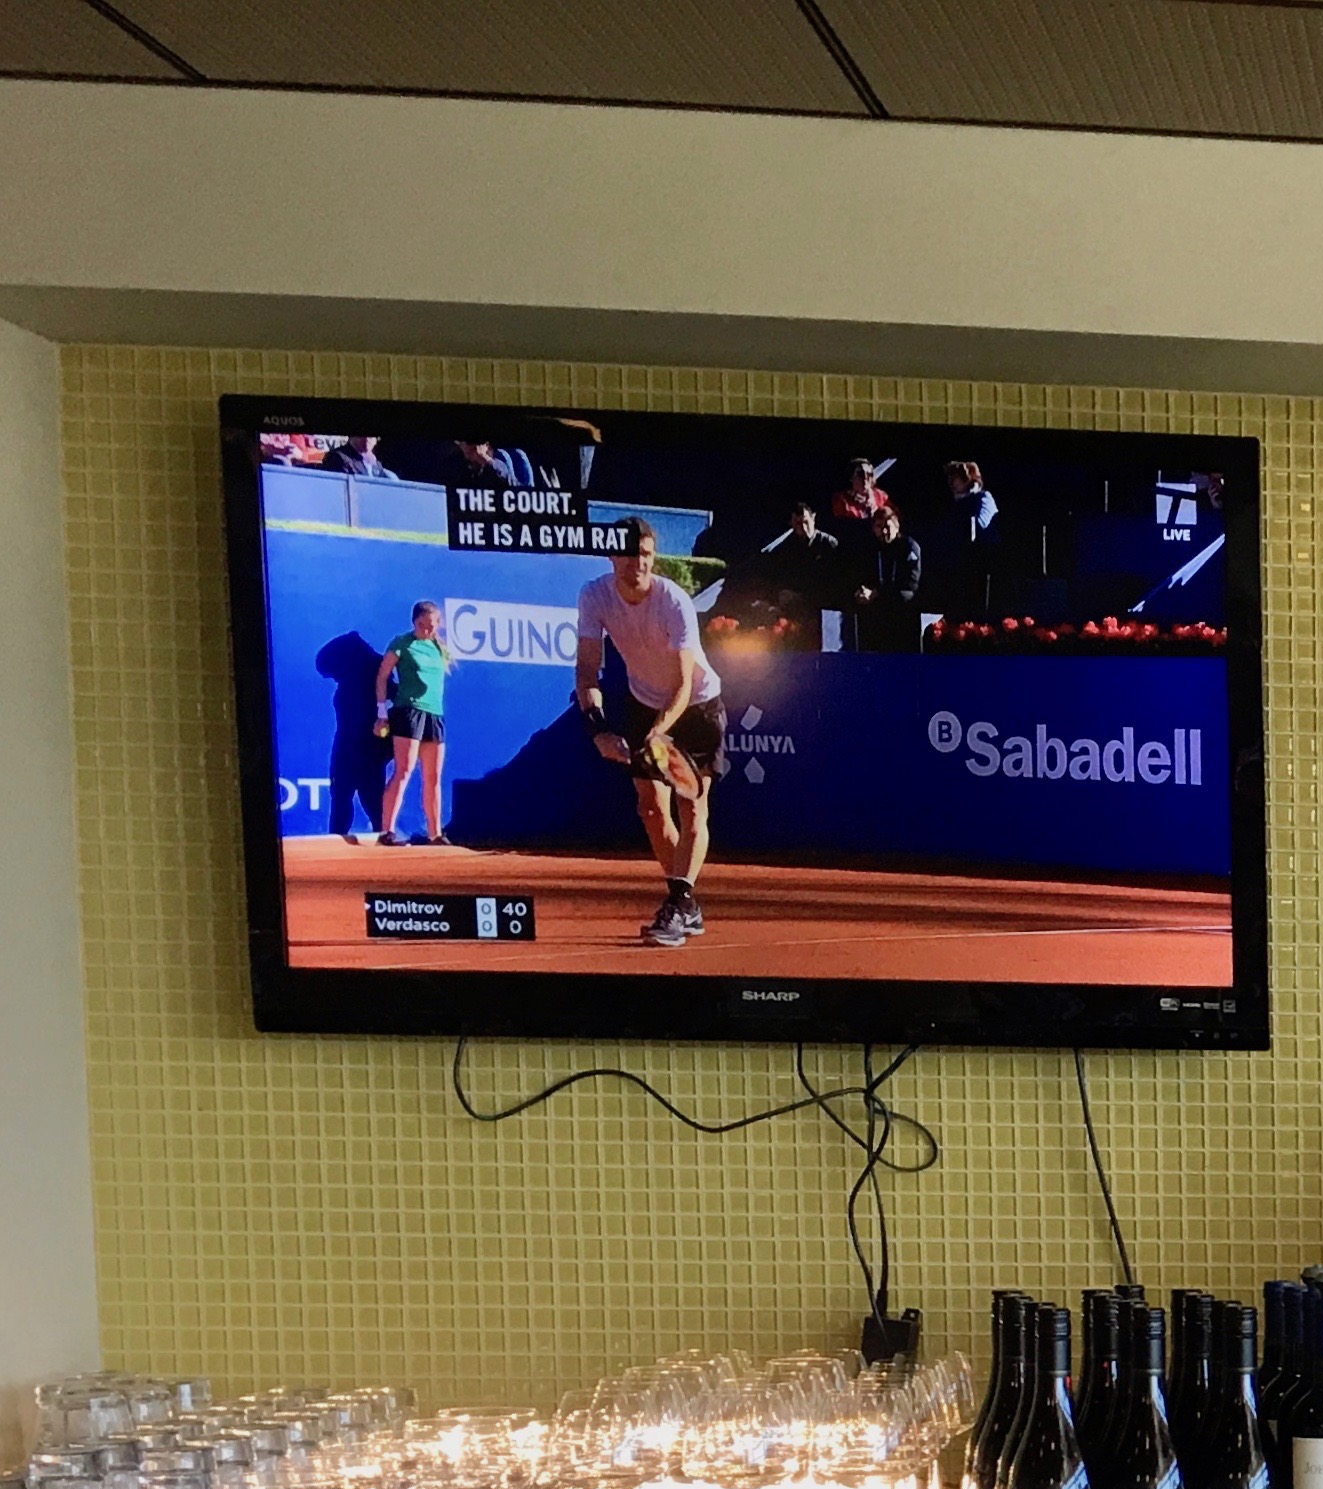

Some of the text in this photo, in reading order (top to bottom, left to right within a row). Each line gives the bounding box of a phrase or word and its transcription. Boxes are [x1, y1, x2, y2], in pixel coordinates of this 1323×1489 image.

[262, 416, 305, 427] AQUOS
[455, 488, 577, 516] THE COURT.
[458, 522, 629, 550] HE IS A GYM RAT
[1162, 529, 1191, 542] LIVE
[965, 722, 1202, 786] Sabadell
[374, 900, 444, 916] Dimitrov
[501, 901, 527, 917] 40
[375, 917, 451, 933] Verdasco
[509, 919, 522, 934] 0
[742, 990, 800, 1002] SHARP
